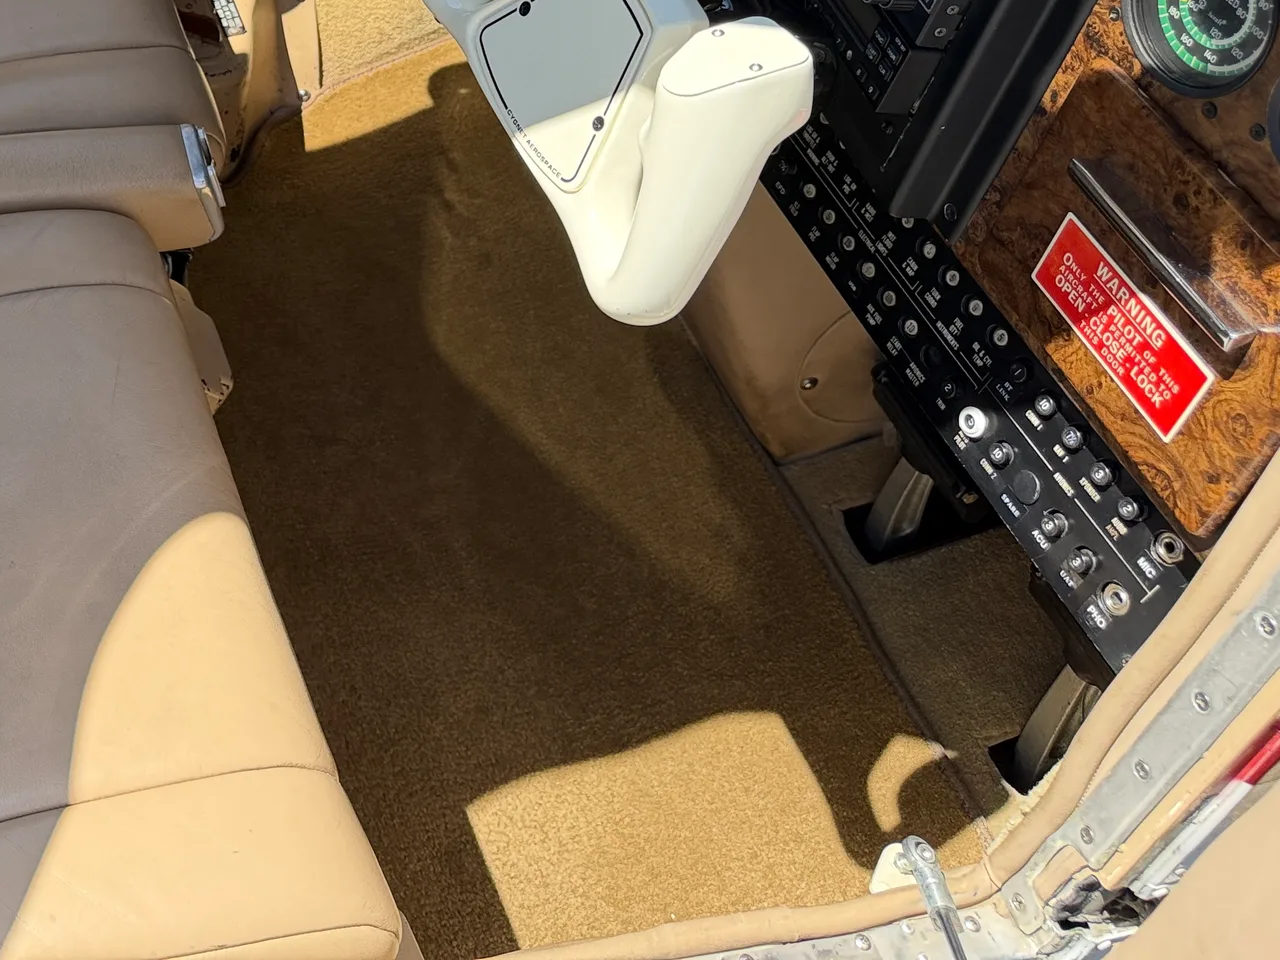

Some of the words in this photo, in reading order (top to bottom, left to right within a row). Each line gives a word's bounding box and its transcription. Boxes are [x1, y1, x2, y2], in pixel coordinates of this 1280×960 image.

[1168, 6, 1182, 18] 180
[1187, 0, 1200, 11] 160
[1258, 0, 1270, 10] 80
[1236, 8, 1248, 19] 80
[1181, 33, 1193, 46] 160
[1210, 27, 1222, 41] 120
[1250, 25, 1264, 39] 100
[1204, 50, 1217, 63] 140
[1231, 47, 1243, 59] 120
[507, 109, 527, 139] CYGNET
[526, 139, 561, 178] AEROSPACE
[812, 226, 820, 236] FLAP
[858, 230, 875, 253] ELECTRICAL
[875, 241, 888, 256] LIGHTS
[826, 256, 836, 270] MOTOR
[831, 252, 839, 262] FLAP
[907, 257, 918, 271] CABIN
[925, 292, 937, 308] COORD
[931, 287, 941, 300] TURN
[1098, 263, 1165, 346] WARNING
[866, 313, 876, 325] PUMP
[873, 312, 882, 324] FUEL
[954, 318, 963, 331] FUEL
[936, 321, 959, 350] INSTRUMENTS
[1060, 266, 1097, 309] AIRCRAFT
[1098, 312, 1108, 323] IS
[1109, 325, 1156, 381] PERMITTED
[1159, 384, 1171, 399] TO
[1089, 284, 1105, 304] THE
[1107, 306, 1142, 345] PILOT
[1143, 351, 1156, 363] OF
[1159, 368, 1179, 393] THIS
[891, 336, 902, 350] START
[1056, 275, 1085, 312] OPEN
[1090, 317, 1126, 362] CLOSE
[1131, 366, 1163, 407] LOCK
[1080, 320, 1099, 344] THIS
[1101, 347, 1124, 376] DOOR
[887, 342, 898, 356] RELAY
[972, 342, 980, 352] OIL
[983, 356, 992, 366] CYL
[973, 354, 983, 366] TEMP
[906, 368, 919, 386] MASTER
[910, 362, 925, 383] AVIONICS
[996, 384, 1009, 401] LINK
[936, 398, 946, 410] TRIM
[954, 435, 966, 450] PILOT
[1054, 473, 1074, 496] AVIONICS
[1079, 477, 1100, 502] XPONDER
[1002, 494, 1020, 517] SPARE
[1111, 518, 1127, 534] AUDIO
[1032, 530, 1048, 549] ACU
[1137, 557, 1156, 578] MIC
[1060, 570, 1074, 586] UAT
[1087, 605, 1106, 629] PHO
